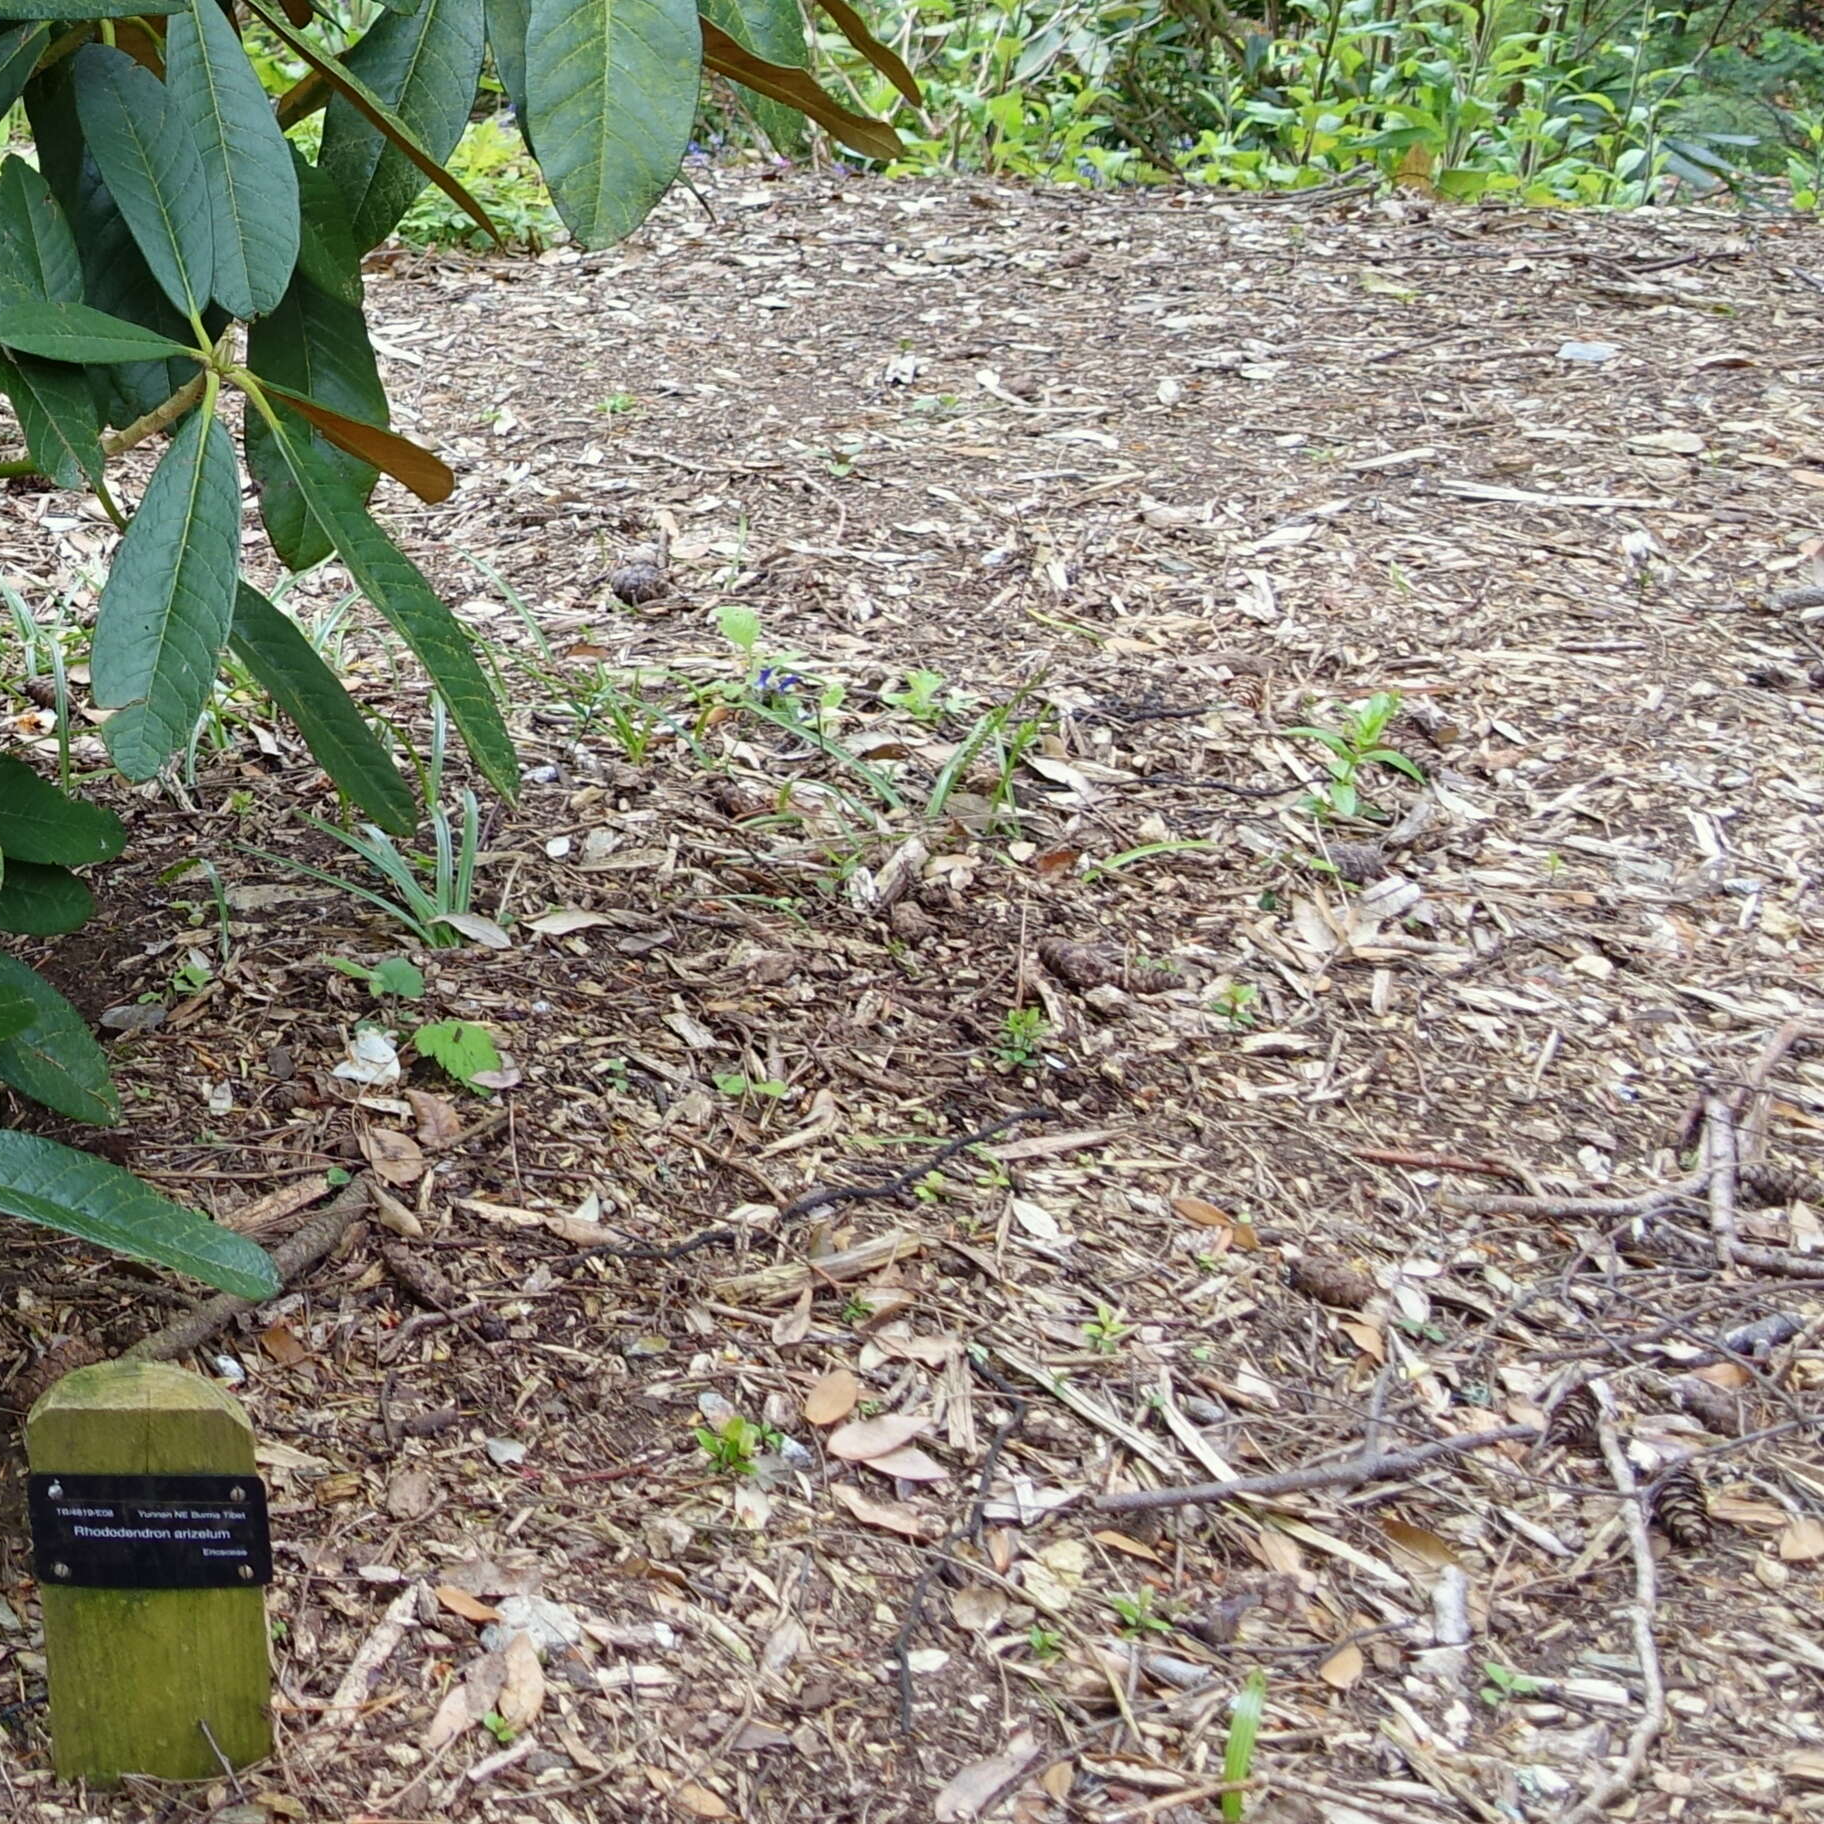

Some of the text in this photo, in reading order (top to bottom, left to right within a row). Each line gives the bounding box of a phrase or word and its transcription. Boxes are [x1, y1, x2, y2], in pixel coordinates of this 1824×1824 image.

[137, 1509, 246, 1520] Yunnan NE Burma Tibet
[74, 1525, 231, 1539] Rhododendron arizelum
